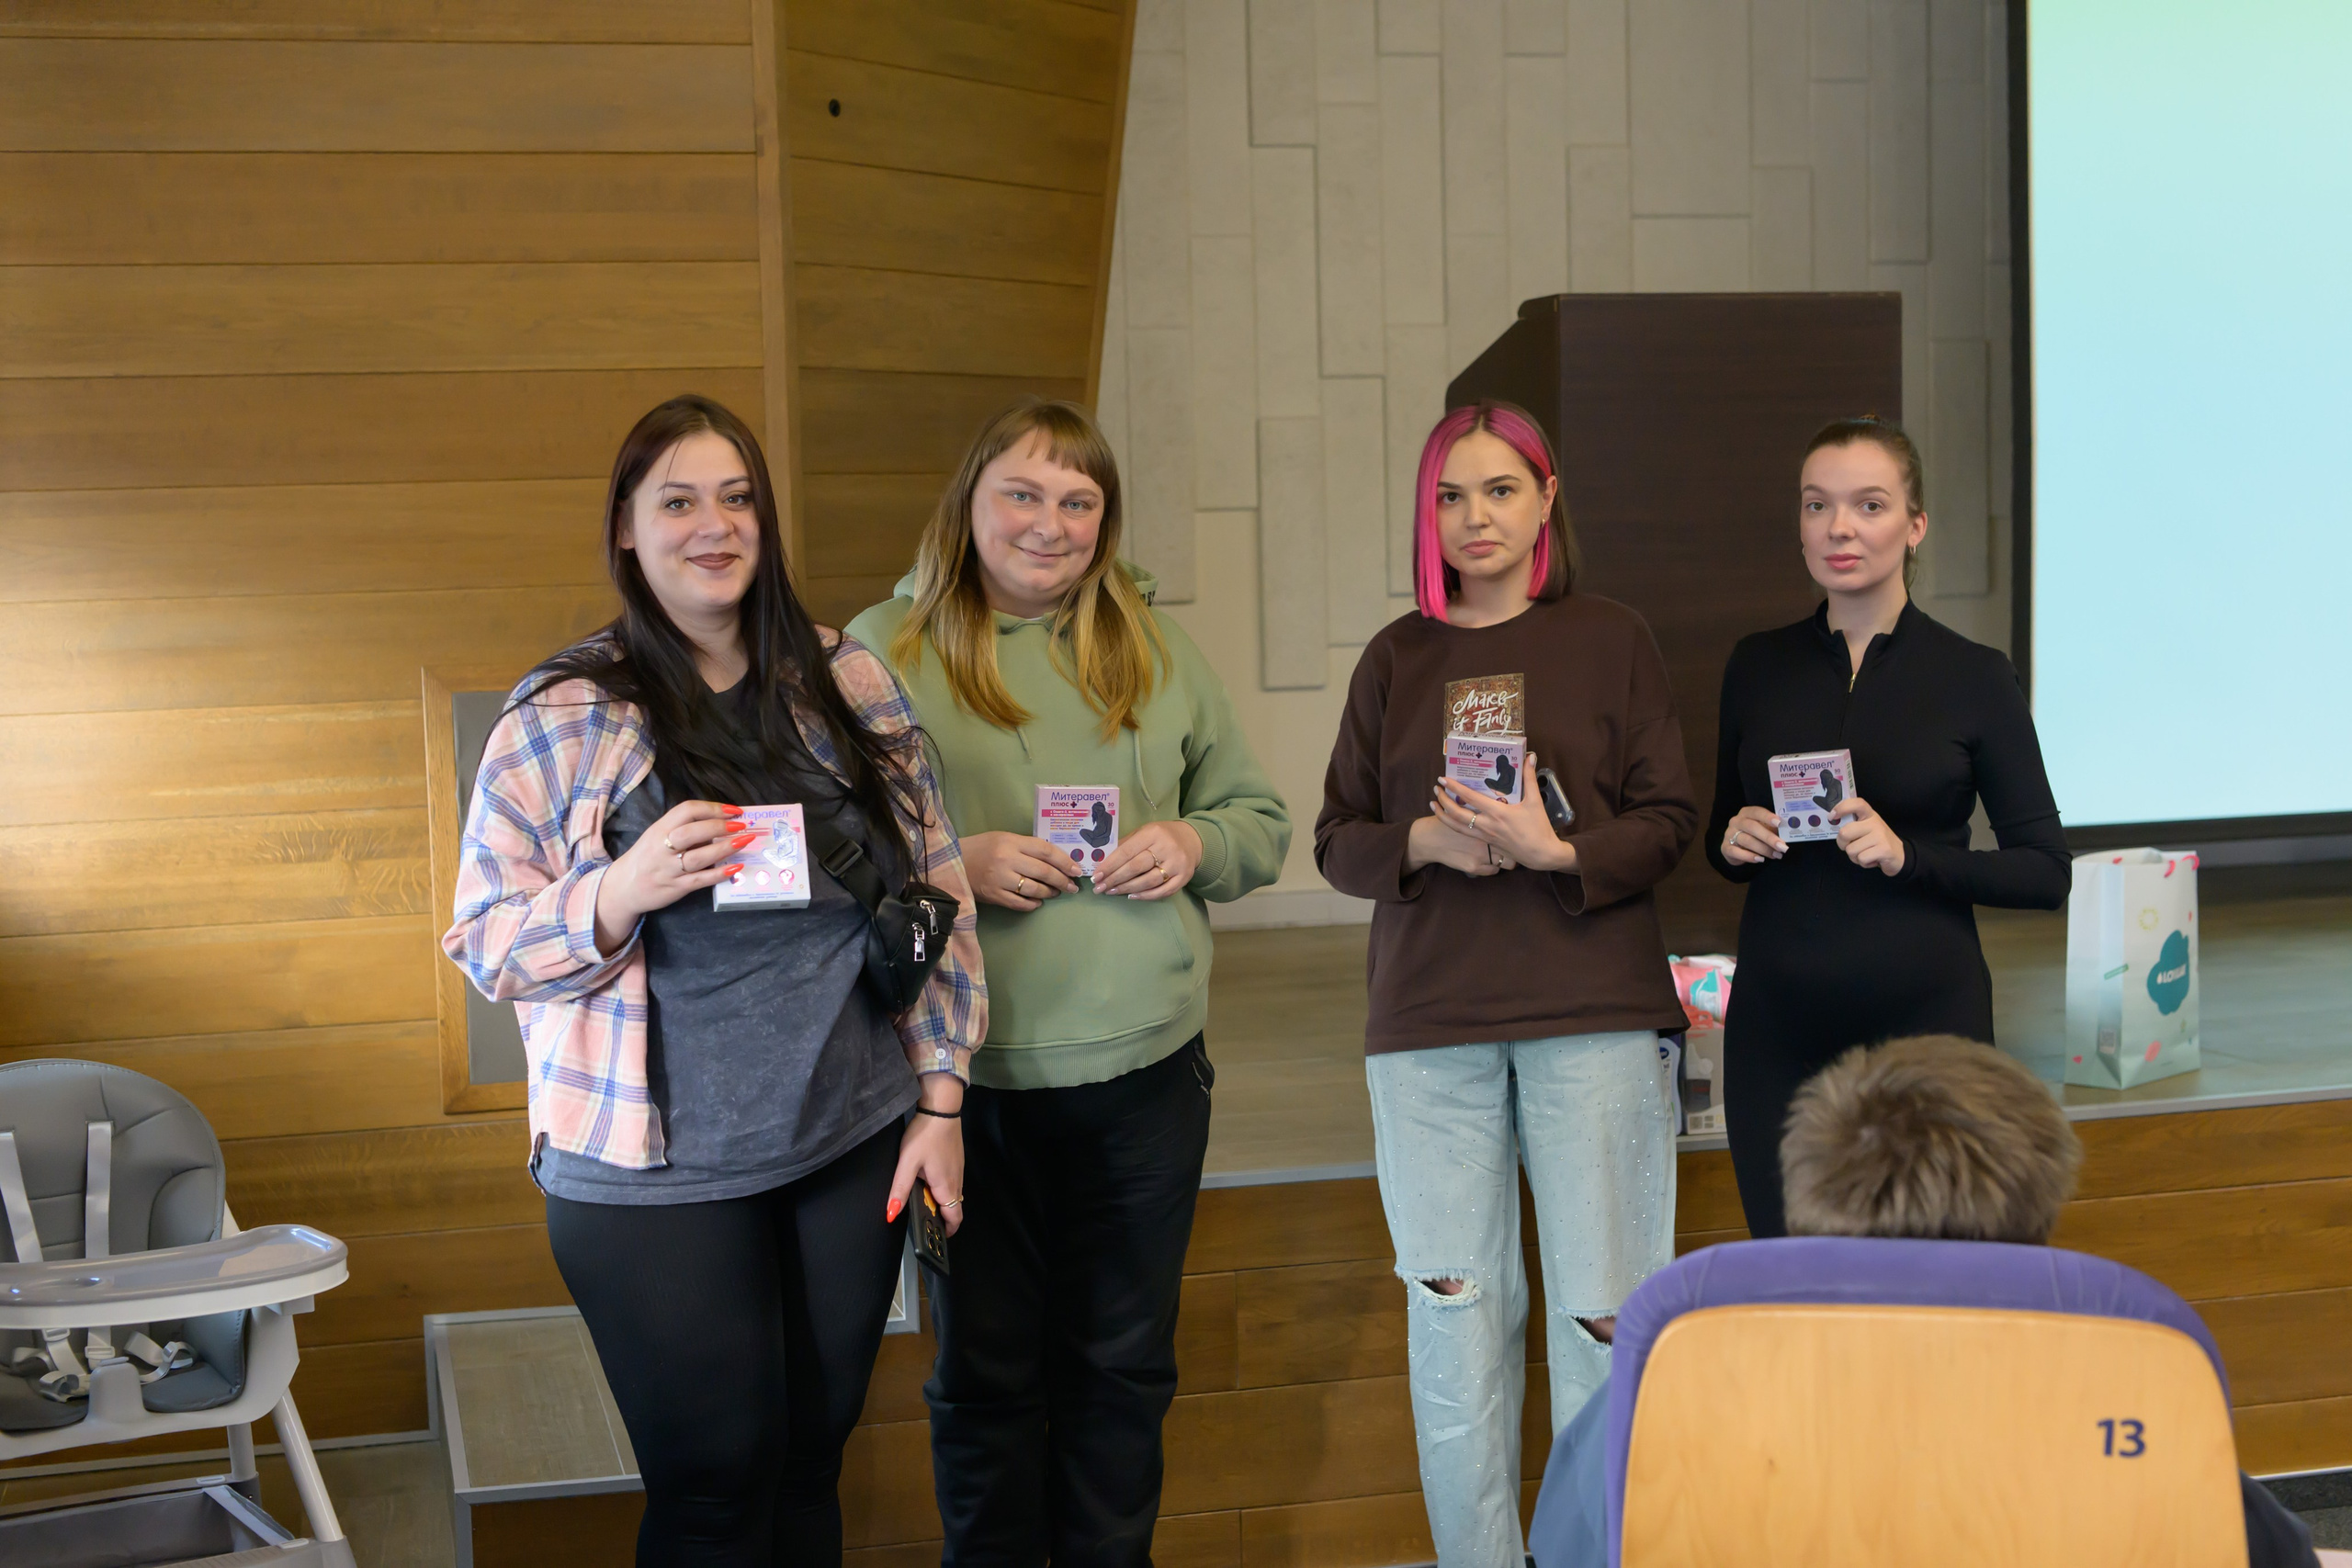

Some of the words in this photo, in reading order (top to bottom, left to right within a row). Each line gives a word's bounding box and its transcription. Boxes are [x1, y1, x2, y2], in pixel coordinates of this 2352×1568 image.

[1457, 742, 1510, 754] Митеравел
[1780, 761, 1833, 773] Митеравел
[1050, 792, 1107, 803] Митеравел
[2097, 1418, 2145, 1458] 13
